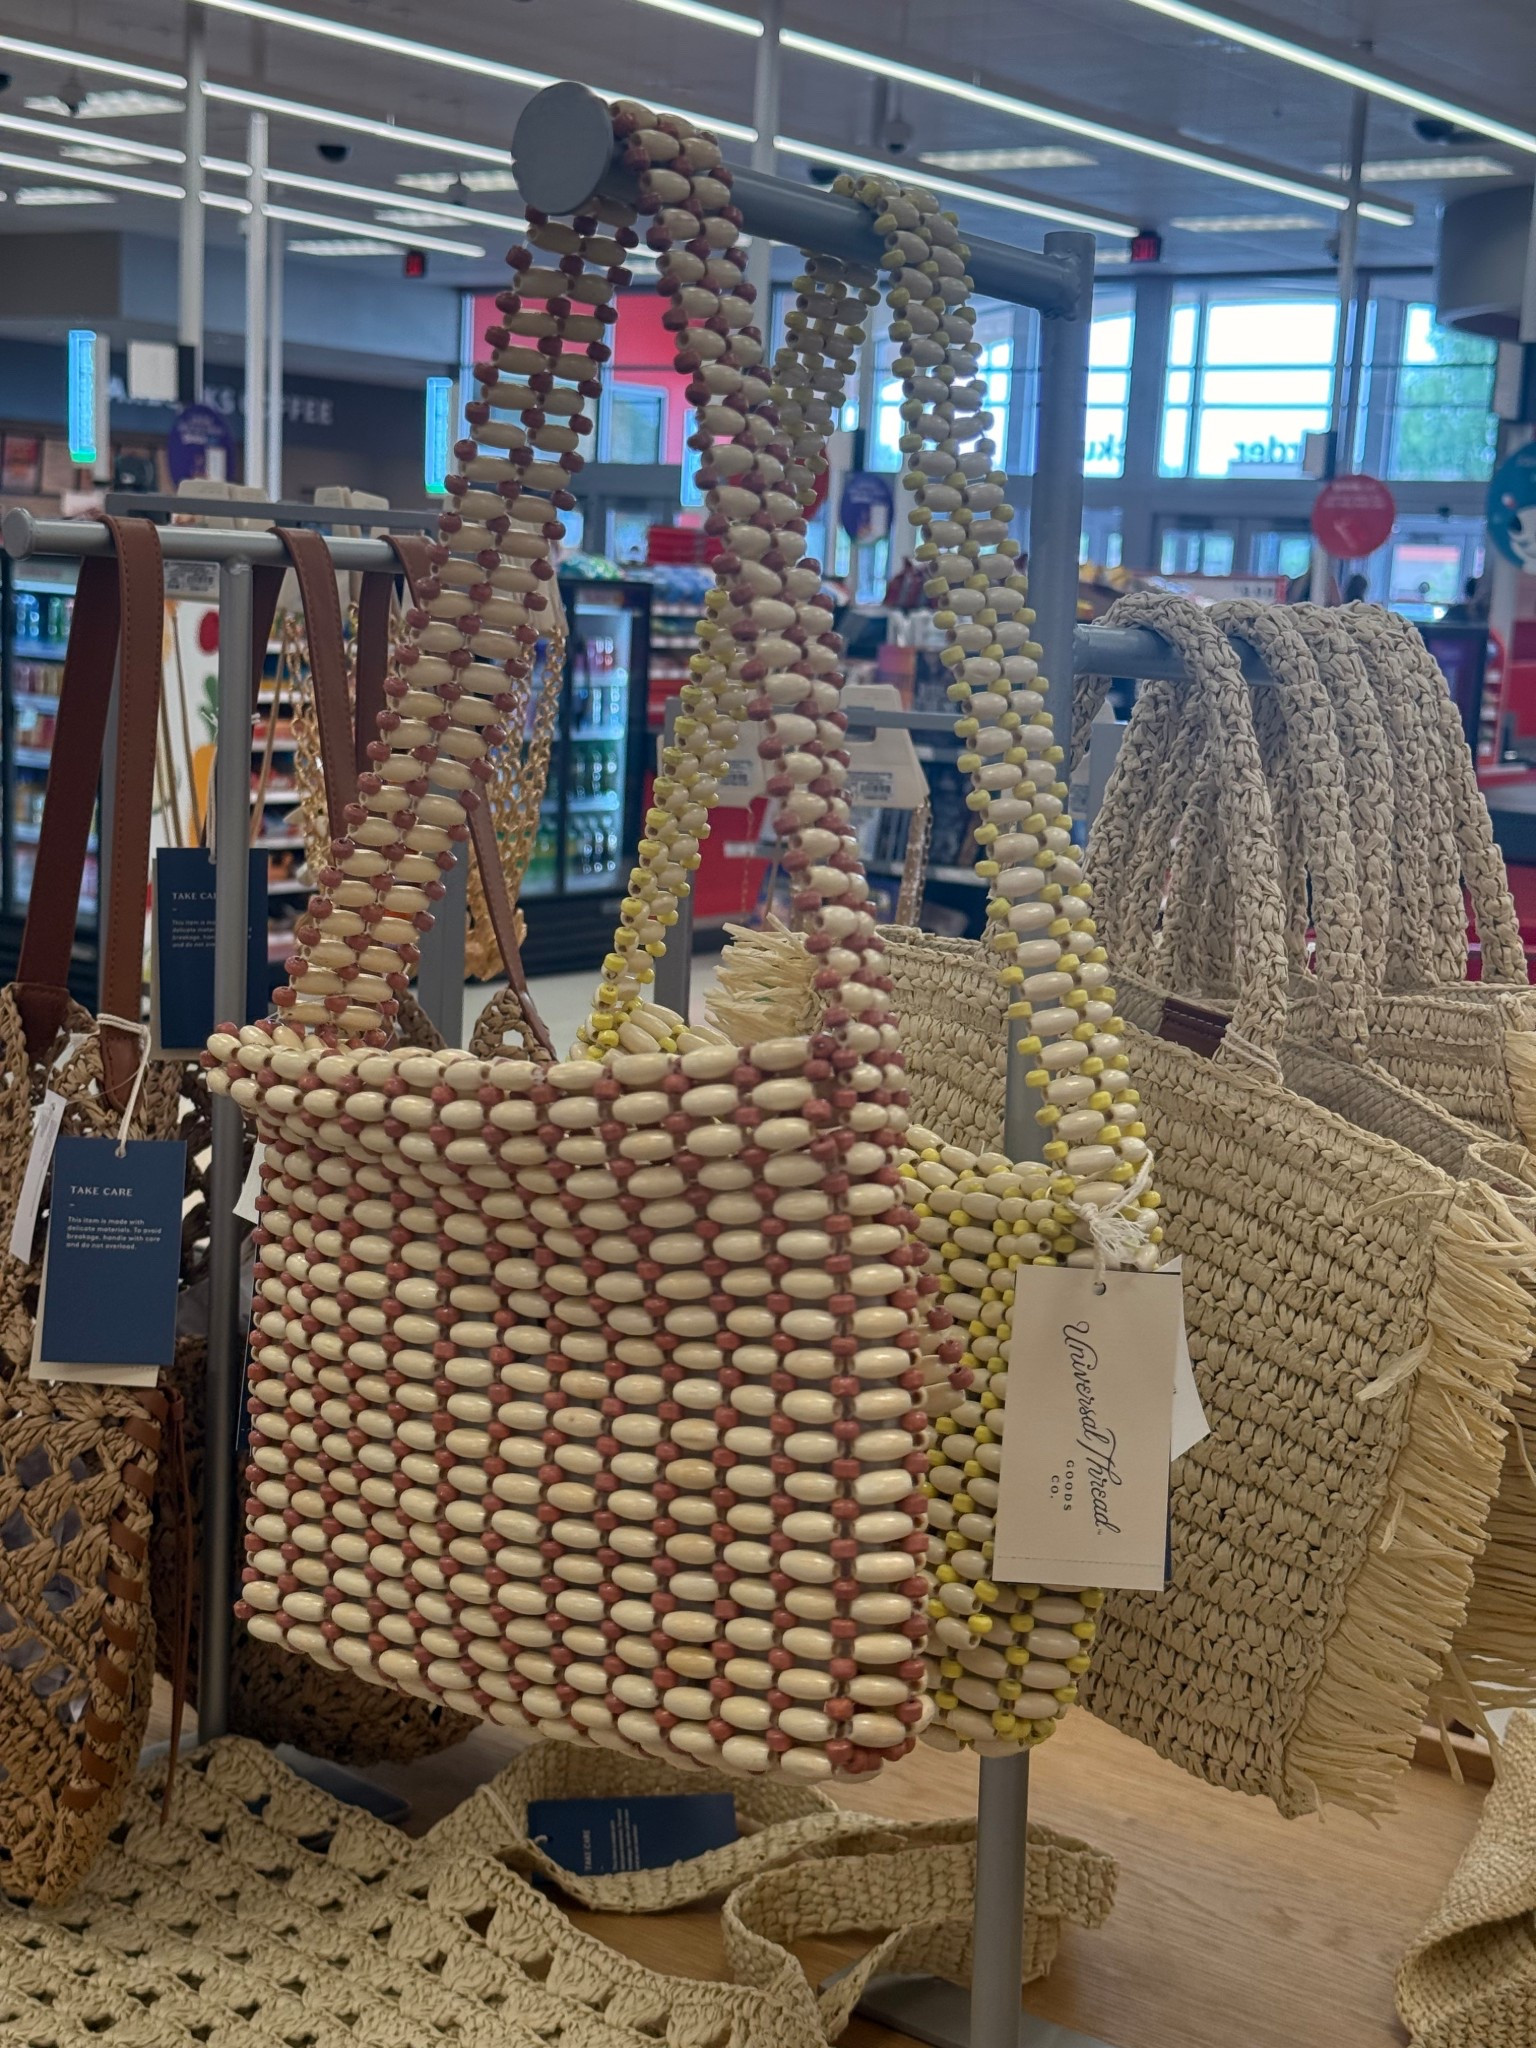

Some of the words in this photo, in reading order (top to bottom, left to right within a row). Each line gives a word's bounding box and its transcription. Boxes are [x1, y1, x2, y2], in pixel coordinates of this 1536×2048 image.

[172, 892, 197, 900] TAKE
[70, 1185, 100, 1196] TAKE
[103, 1187, 133, 1197] CARE
[68, 1215, 82, 1223] This
[105, 1243, 137, 1251] overload.
[1063, 1320, 1110, 1445] Universal
[1050, 1474, 1060, 1499] CO.
[1063, 1459, 1075, 1511] GOODS
